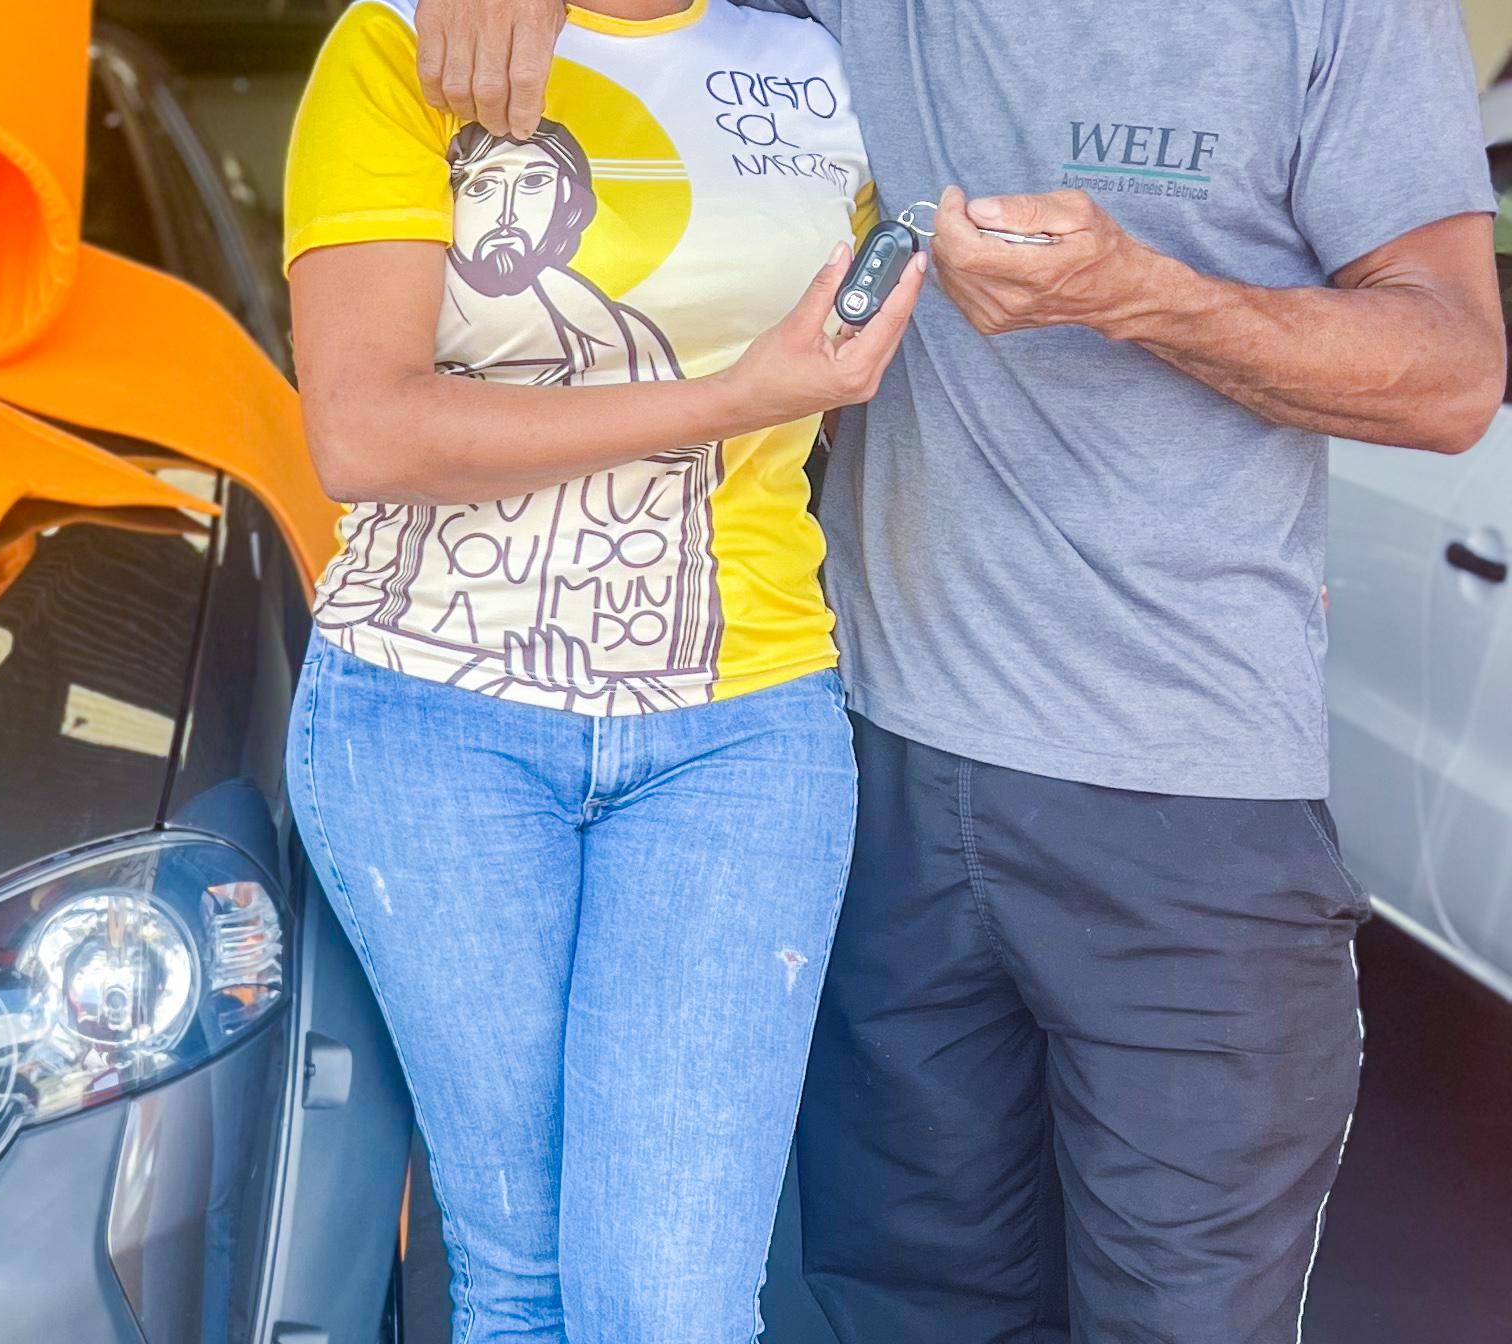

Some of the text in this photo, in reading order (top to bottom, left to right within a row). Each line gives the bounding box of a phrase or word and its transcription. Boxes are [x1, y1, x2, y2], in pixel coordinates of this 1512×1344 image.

[706, 70, 837, 119] CRISTO
[1069, 120, 1219, 172] WELF
[437, 511, 540, 585] SOU
[572, 528, 668, 573] DO
[431, 590, 479, 644] A
[591, 609, 668, 652] DO
